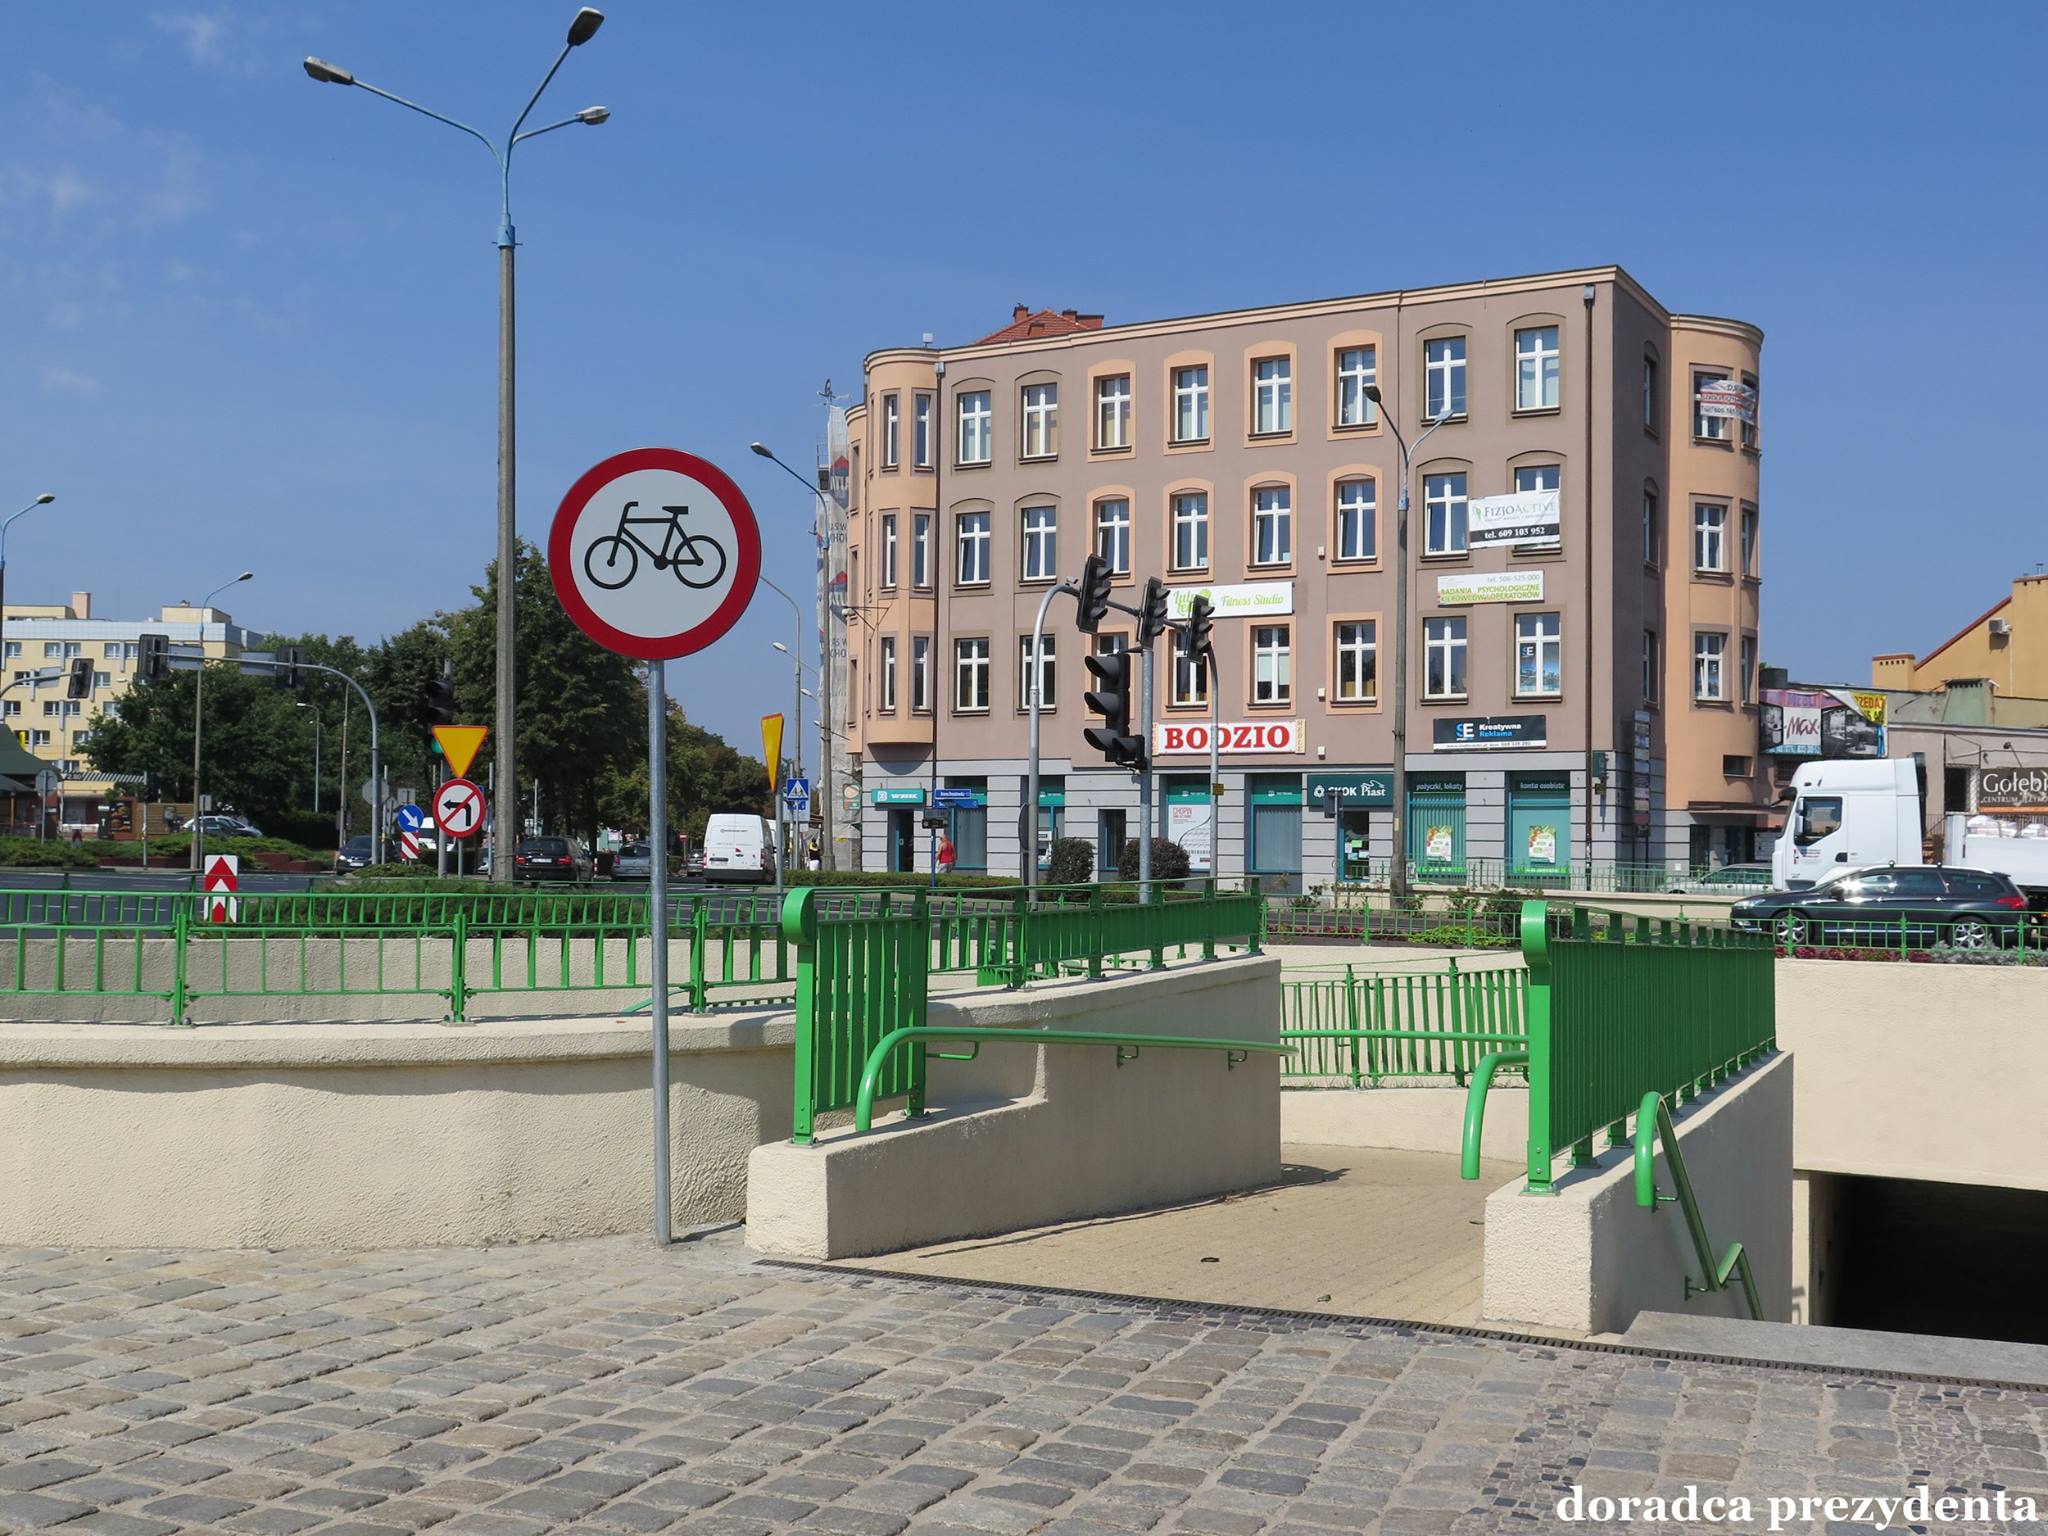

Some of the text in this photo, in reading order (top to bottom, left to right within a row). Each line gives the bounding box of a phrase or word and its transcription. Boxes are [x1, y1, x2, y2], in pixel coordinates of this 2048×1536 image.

[1484, 526, 1546, 539] tel. 609 103 952
[1479, 723, 1522, 731] Kreatywna
[1787, 716, 1819, 739] Max
[1164, 725, 1290, 749] BODZIO
[1361, 785, 1386, 796] Piast
